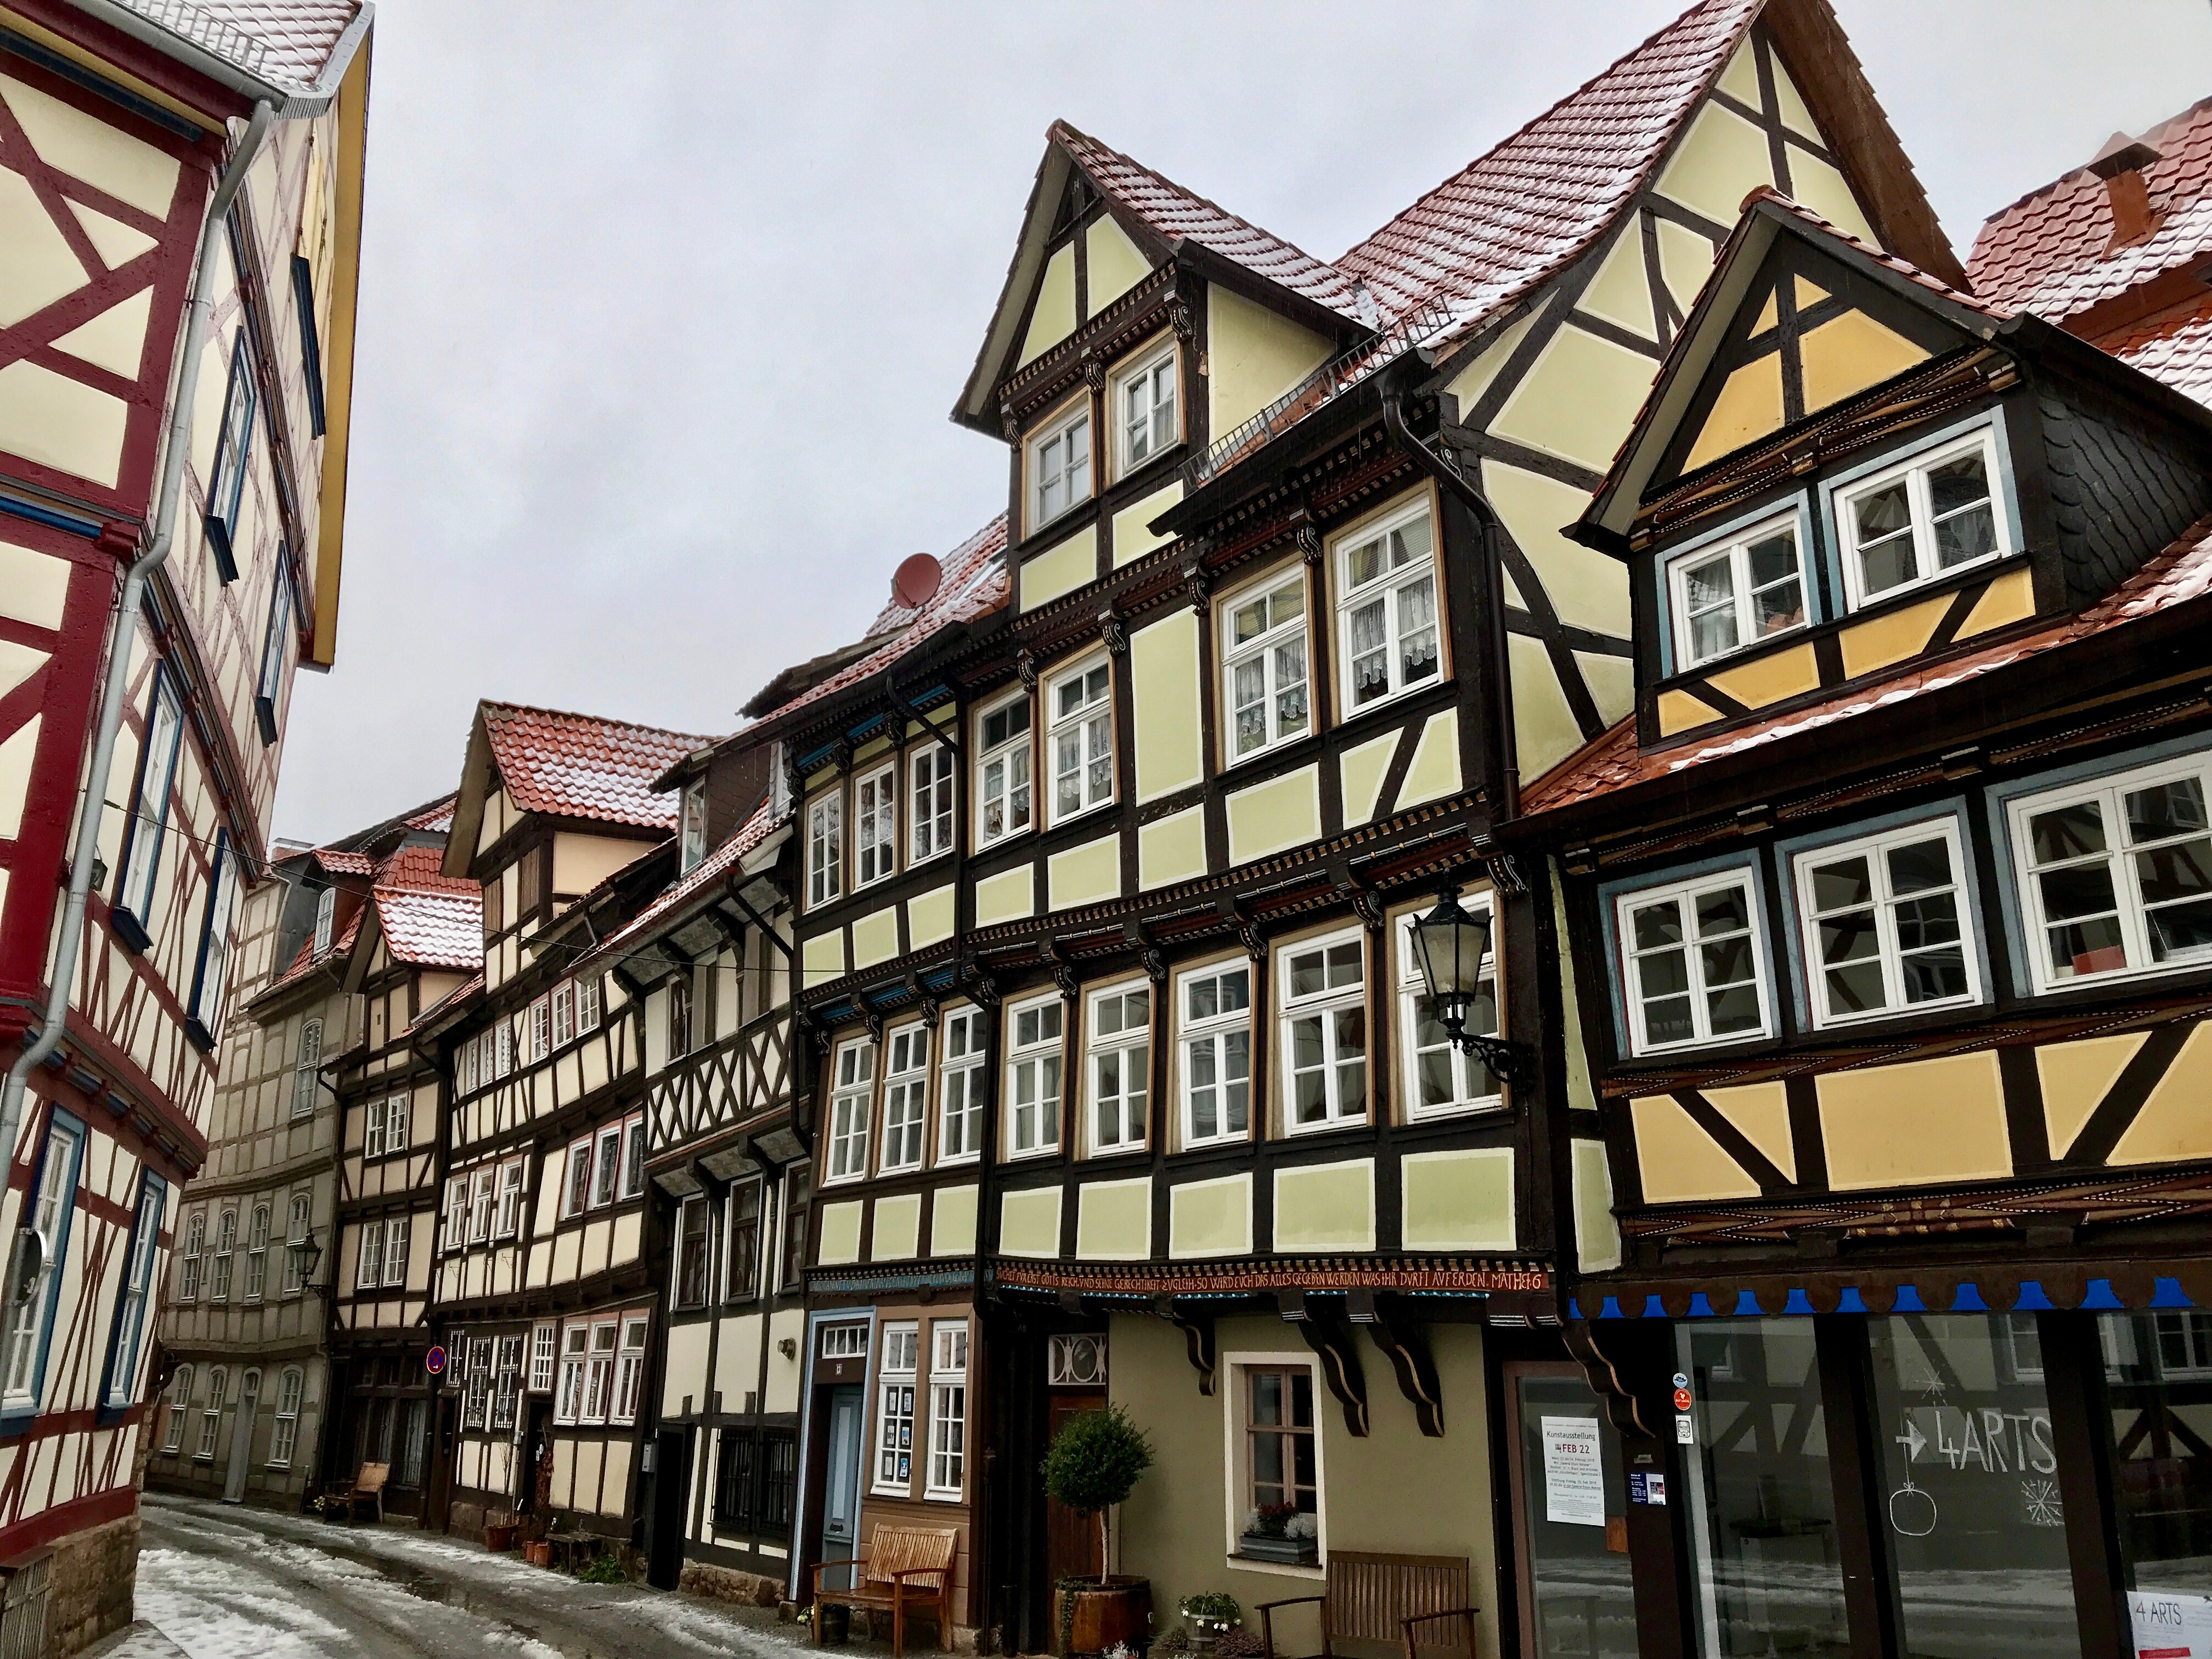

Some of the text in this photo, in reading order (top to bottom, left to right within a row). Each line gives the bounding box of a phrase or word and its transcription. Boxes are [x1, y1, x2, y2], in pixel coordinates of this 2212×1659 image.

[1210, 1276, 1233, 1289] WIRD
[1255, 1274, 1268, 1288] DAS
[1269, 1273, 1291, 1287] ALLES
[1292, 1272, 1325, 1285] GEGEBEN
[1325, 1272, 1360, 1286] WERDEN
[1361, 1272, 1380, 1286] WAS
[1547, 1431, 1595, 1441] Kunstausstellung
[1562, 1444, 1590, 1454] FEB 22
[2136, 1601, 2146, 1622] 4
[2150, 1601, 2182, 1626] ARTS
